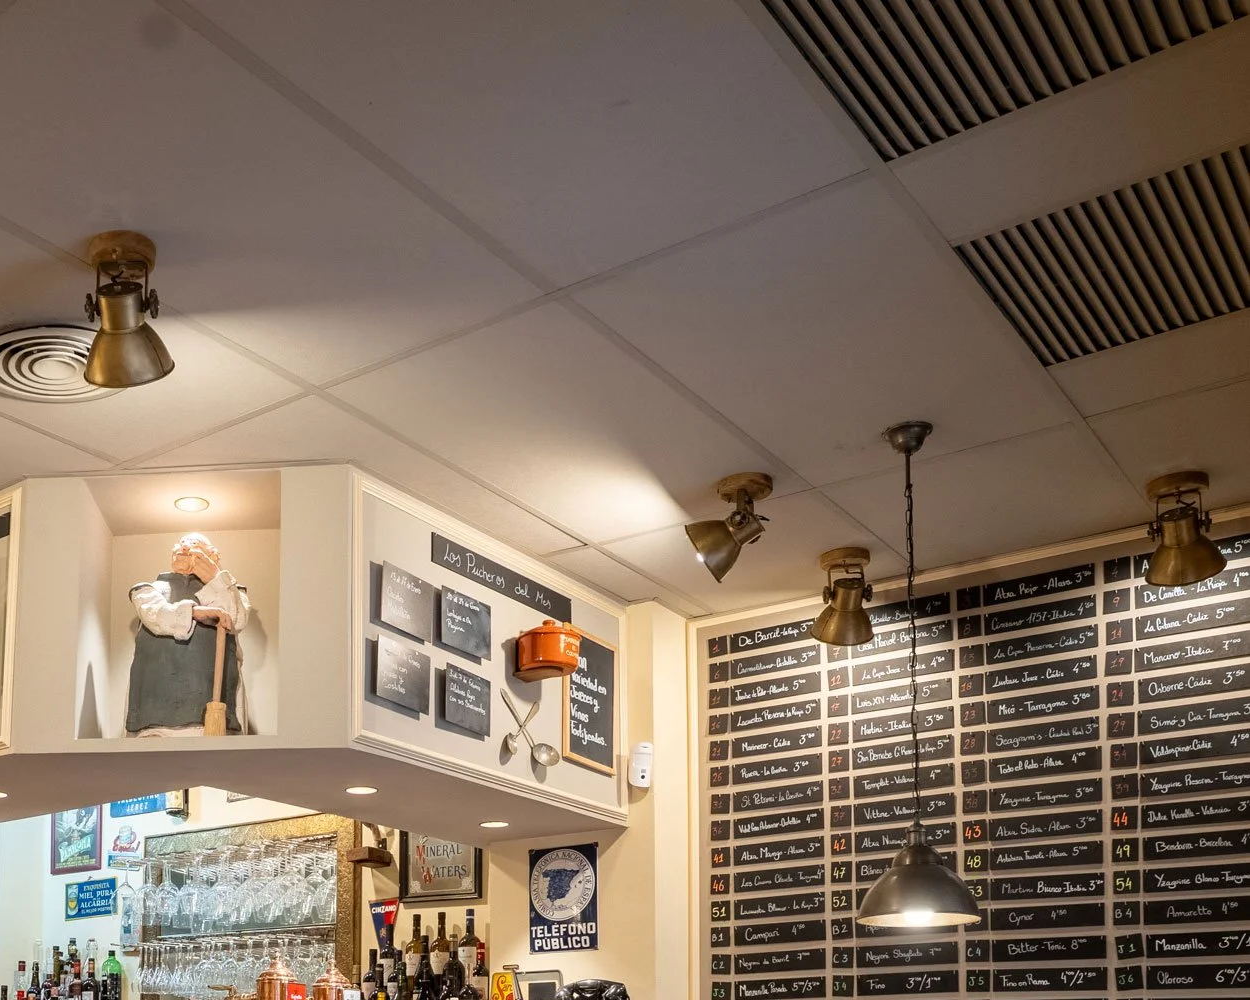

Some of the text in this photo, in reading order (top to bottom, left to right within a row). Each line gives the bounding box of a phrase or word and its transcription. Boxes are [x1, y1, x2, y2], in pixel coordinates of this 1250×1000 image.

[444, 544, 552, 610] Los Pucheros del Mes
[1112, 596, 1120, 607] 9
[1144, 591, 1158, 604] De
[1144, 618, 1182, 633] La Gitana
[738, 636, 754, 647] De
[1114, 812, 1128, 827] 44
[964, 825, 982, 840] 43
[834, 838, 846, 851] 42
[1116, 844, 1130, 858] 49
[416, 844, 463, 866] MINERAL
[714, 853, 724, 864] 41
[966, 854, 982, 869] 48
[420, 864, 467, 884] WATERS
[833, 866, 846, 879] 47
[713, 880, 724, 892] 46
[1116, 877, 1132, 892] 54
[79, 891, 94, 900] MIEL
[832, 894, 848, 908] 52
[372, 904, 397, 914] CINZANO
[712, 906, 726, 918] 51
[531, 922, 596, 938] TELÉFONO
[745, 928, 780, 942] Campari
[534, 936, 590, 951] PÚBLICO
[1156, 938, 1208, 952] Manzanilla
[866, 978, 886, 990] Fino
